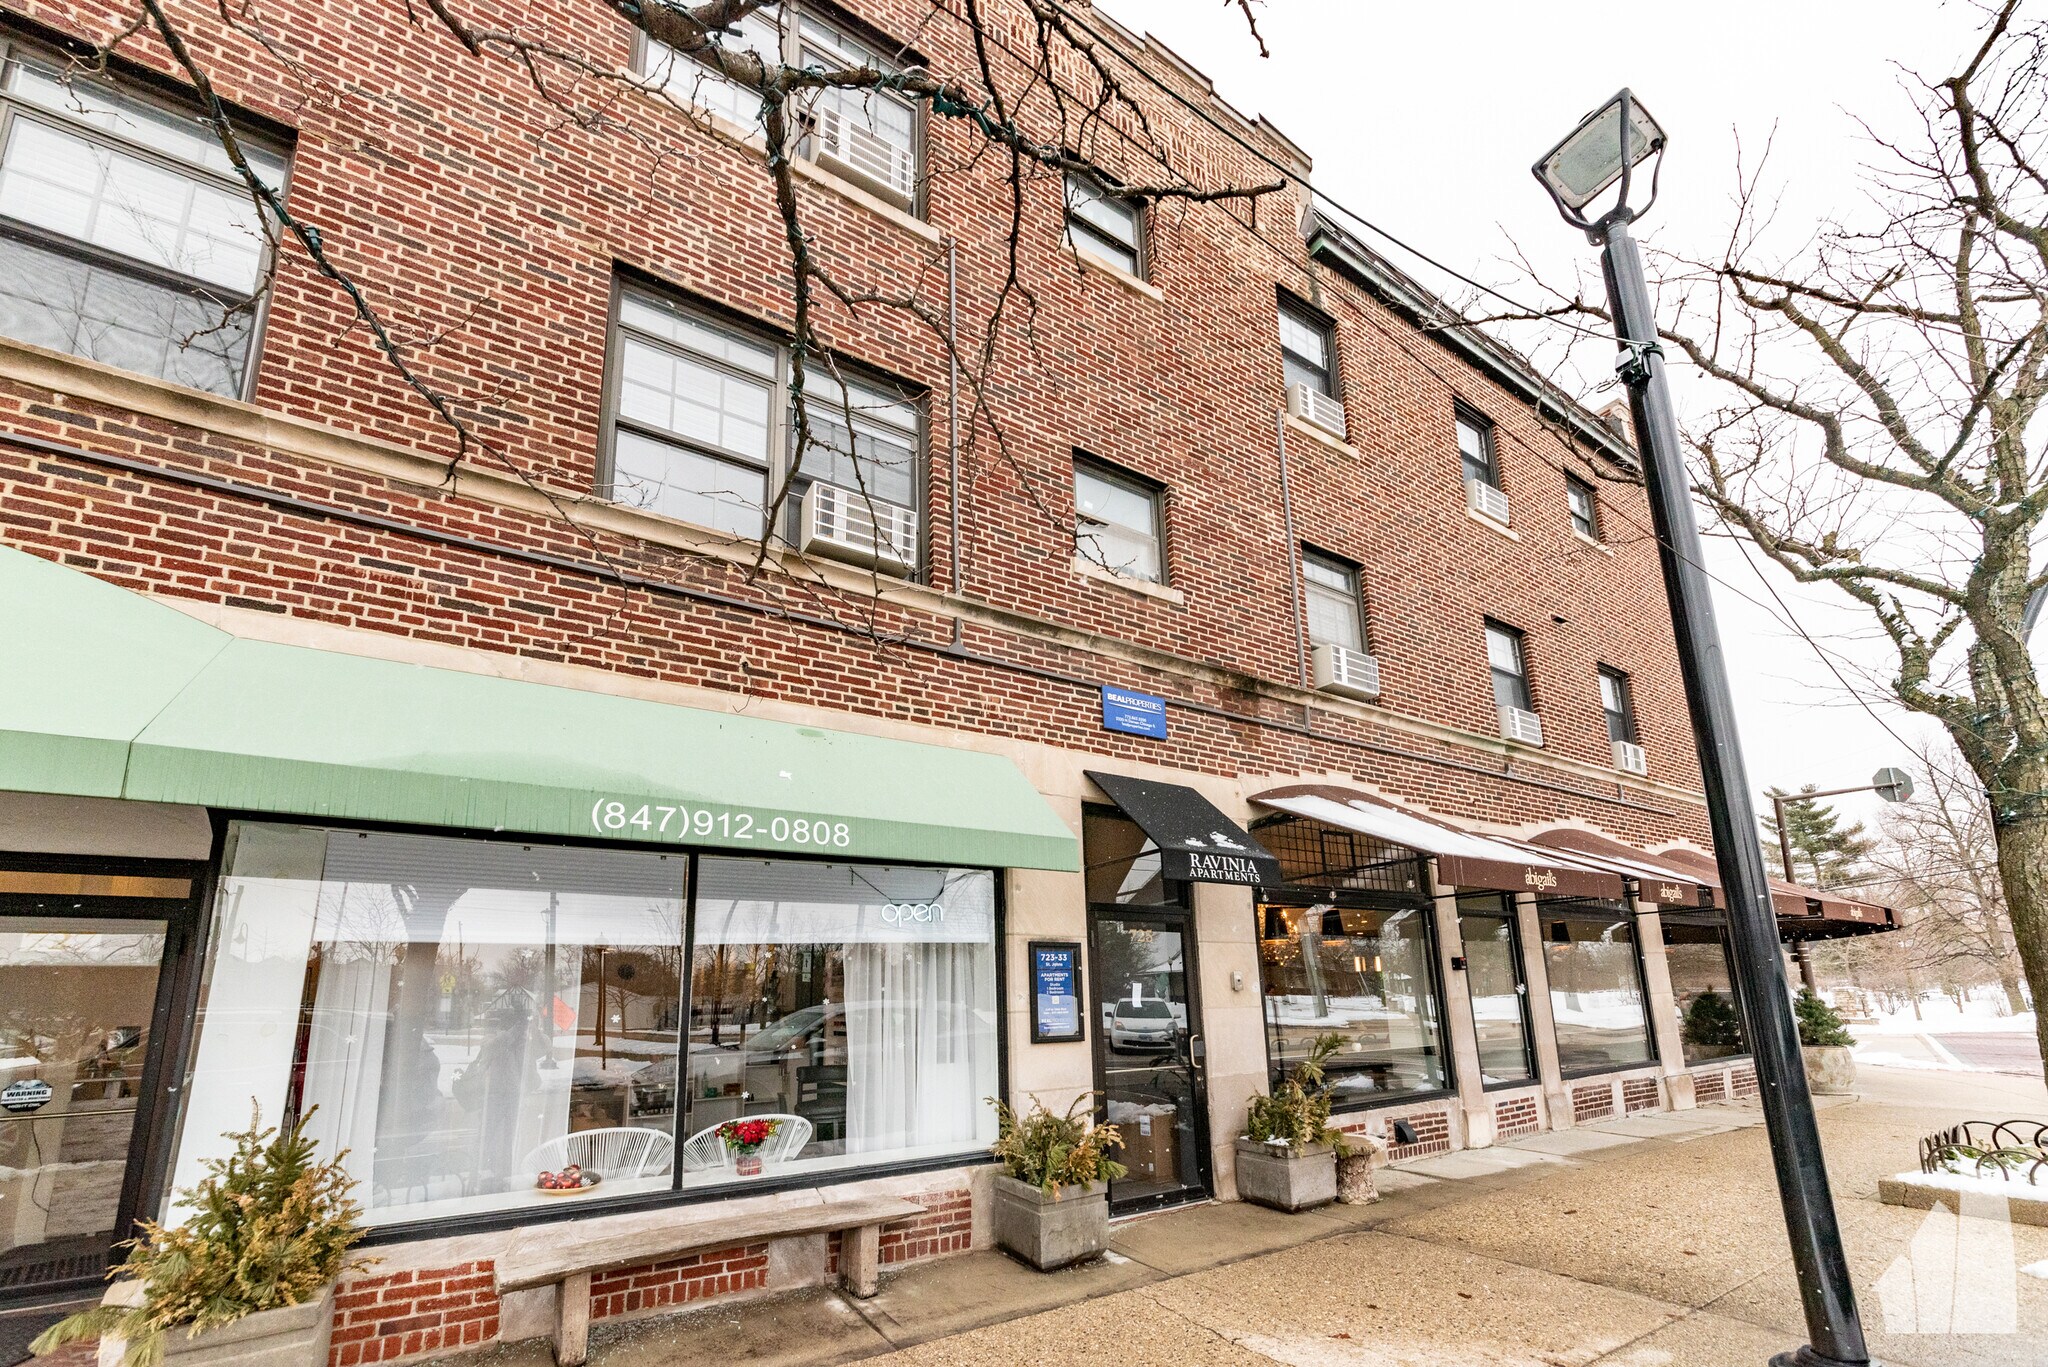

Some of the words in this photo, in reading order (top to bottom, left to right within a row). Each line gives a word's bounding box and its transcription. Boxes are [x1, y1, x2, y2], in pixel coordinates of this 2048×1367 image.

[1107, 693, 1162, 710] BEALPROPERTIES
[591, 798, 850, 847] (847)912-0808
[1189, 853, 1258, 874] RAVINIA
[1189, 868, 1260, 883] APARTMENTS
[1525, 867, 1557, 891] abigail's
[881, 903, 944, 928] open
